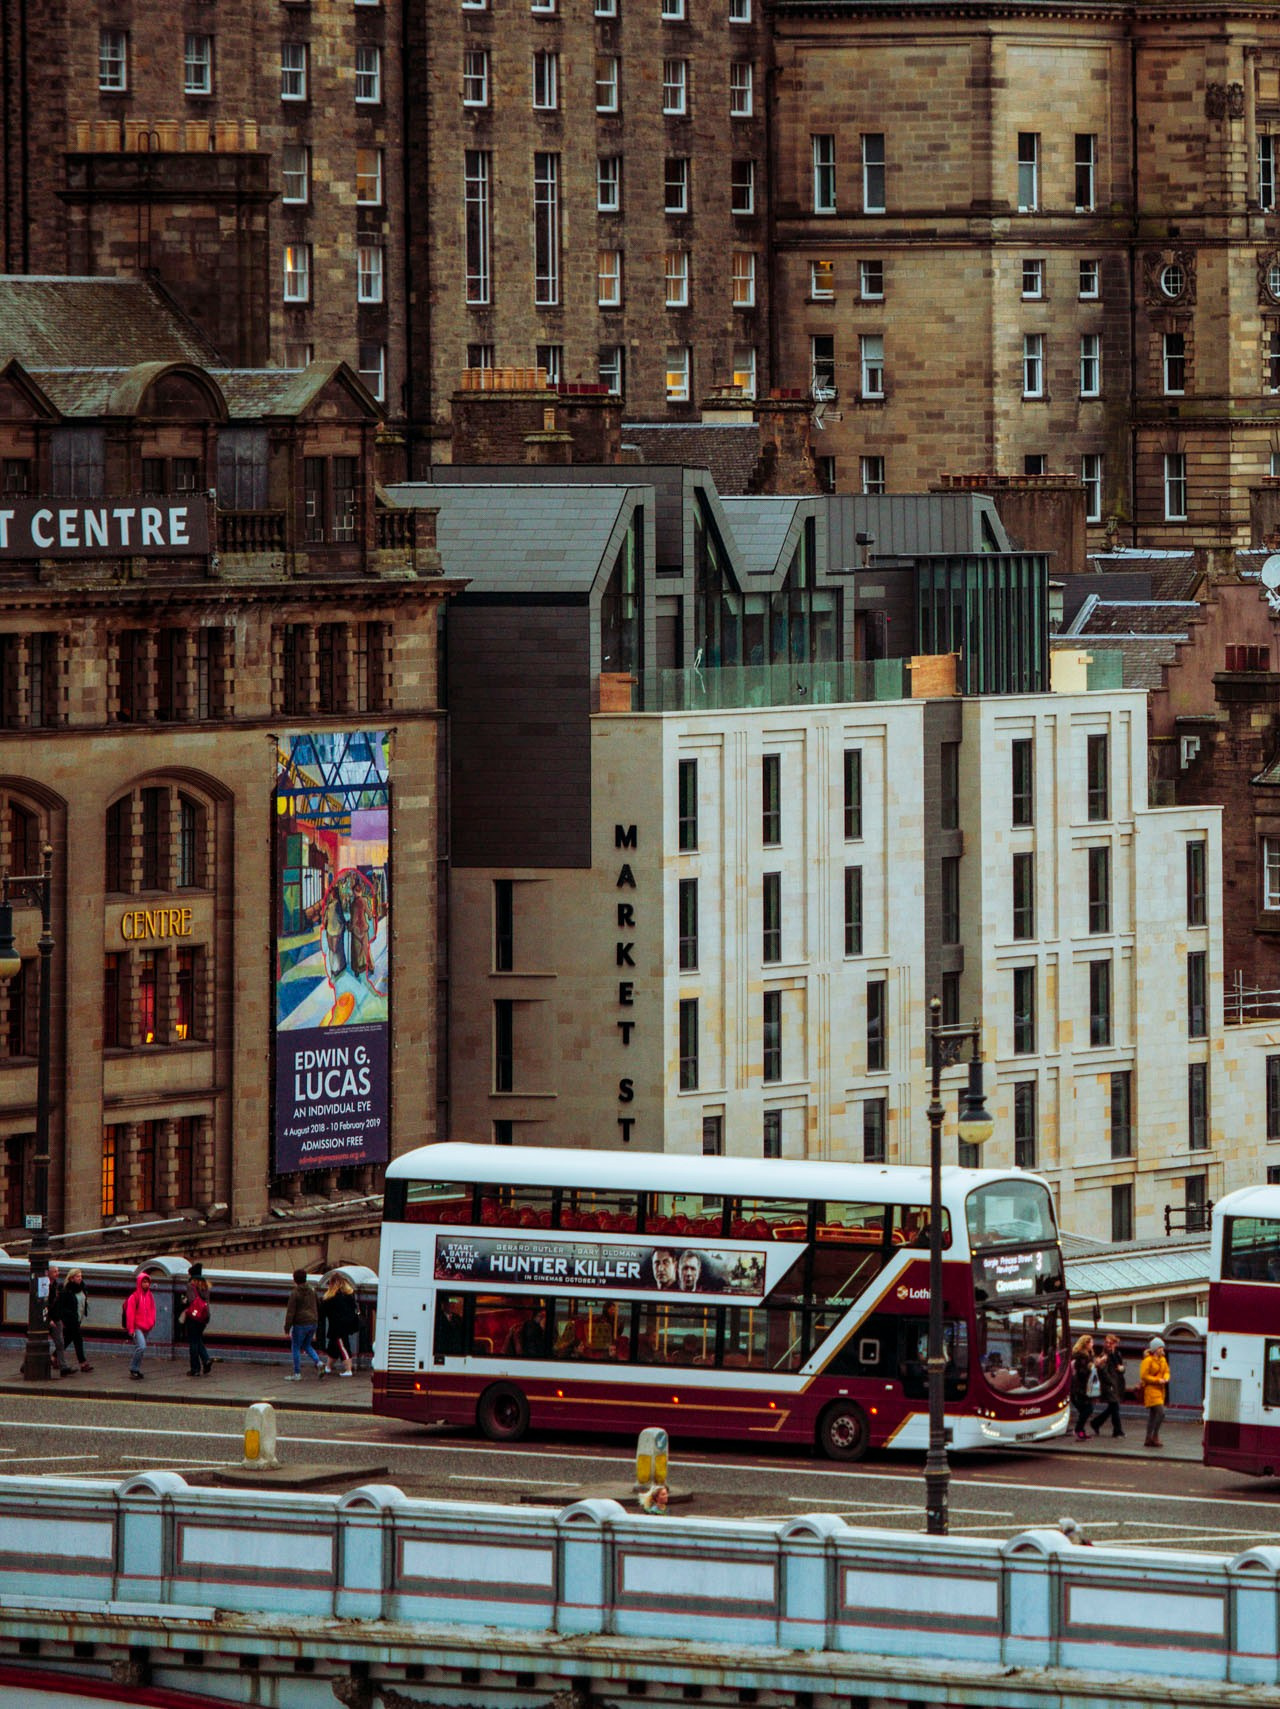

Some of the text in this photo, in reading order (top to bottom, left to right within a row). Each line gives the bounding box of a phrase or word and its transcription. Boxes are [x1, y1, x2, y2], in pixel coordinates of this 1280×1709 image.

[31, 507, 190, 548] CENTRE
[121, 907, 193, 941] CENTRE
[614, 824, 638, 1143] MARKET ST
[295, 1045, 371, 1070] EDWIN G.
[294, 1066, 371, 1102] LUCAS
[293, 1100, 372, 1119] AN INDIVIDUAL EYE
[283, 1128, 289, 1137] 4
[288, 1125, 310, 1138] August
[311, 1122, 326, 1134] 2018
[330, 1121, 339, 1131] 10
[339, 1119, 365, 1132] February
[365, 1117, 381, 1129] 2019
[301, 1135, 364, 1152] ADMISSION FREE
[449, 1250, 480, 1258] BATTLE
[496, 1244, 564, 1254] GERARD BUTLER
[602, 1249, 637, 1257] OLDMAN
[490, 1255, 641, 1279] HUNTER KILLER
[1035, 1251, 1042, 1271] 3
[533, 1275, 563, 1283] CINEMAS
[565, 1277, 596, 1285] OCTOBER
[909, 1287, 931, 1300] Lothi
